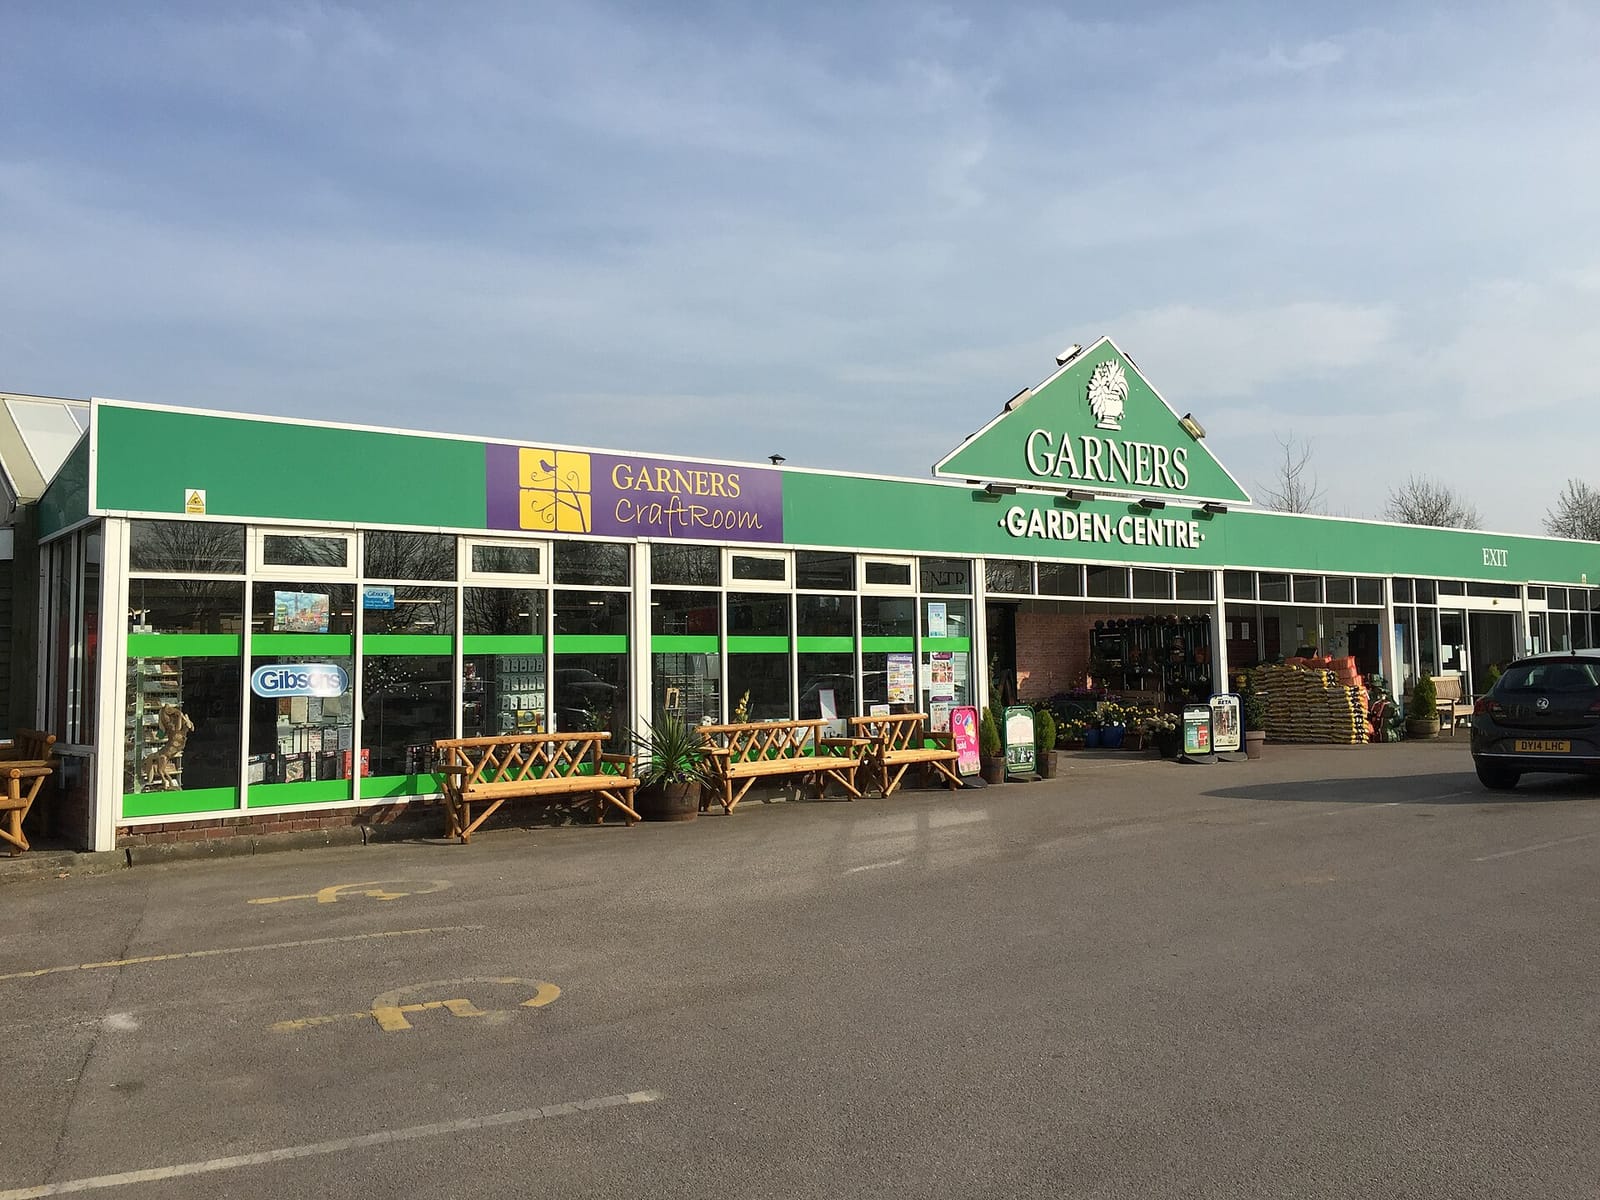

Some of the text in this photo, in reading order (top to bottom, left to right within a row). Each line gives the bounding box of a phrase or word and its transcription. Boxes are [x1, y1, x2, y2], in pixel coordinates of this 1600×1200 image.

[1026, 428, 1189, 490] GARNERS
[611, 463, 741, 499] GARNERS
[615, 495, 763, 537] CraftRoom
[1482, 547, 1509, 567] EXIT
[259, 670, 341, 690] Gibsons
[1521, 741, 1564, 751] DY14 LHC
